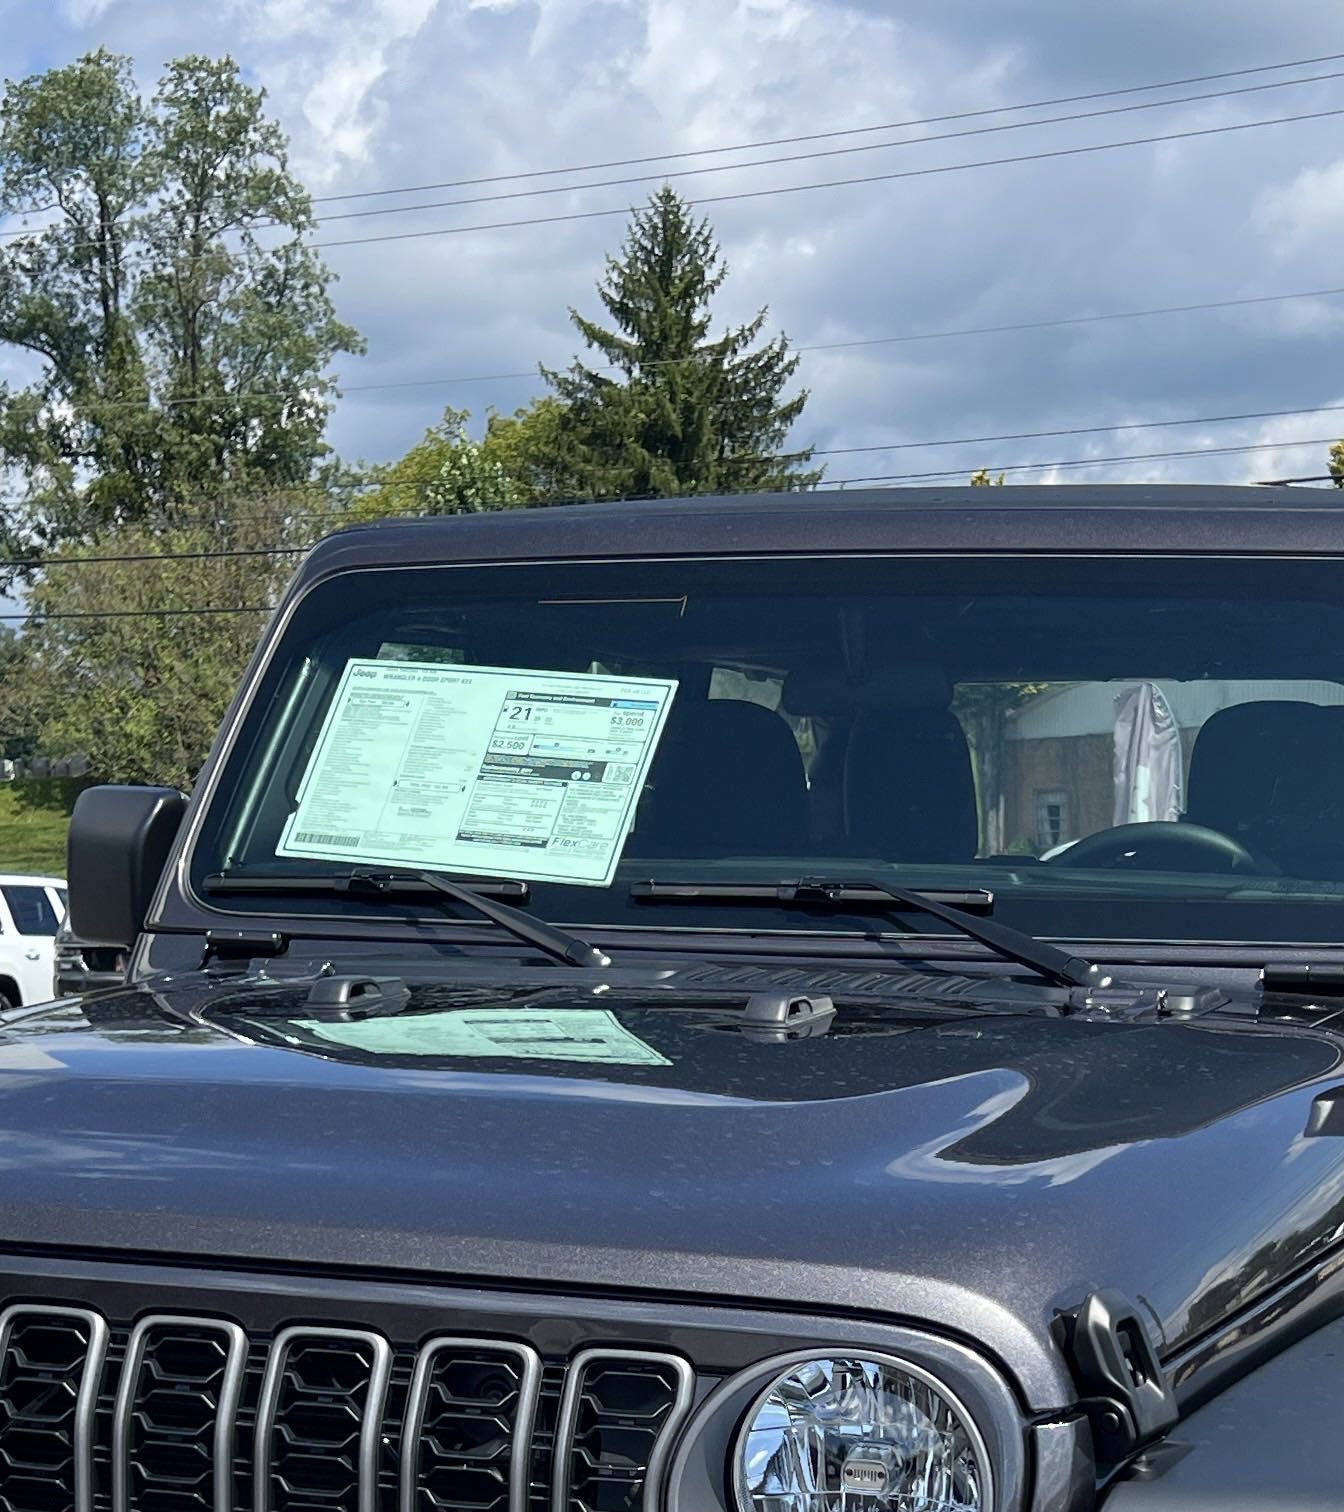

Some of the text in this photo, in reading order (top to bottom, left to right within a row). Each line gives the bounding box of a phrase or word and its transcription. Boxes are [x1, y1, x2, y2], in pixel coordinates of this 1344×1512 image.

[509, 706, 532, 721] 21
[609, 717, 644, 727] $3,000
[491, 739, 525, 750] $2,500
[551, 836, 609, 849] FlexCare
